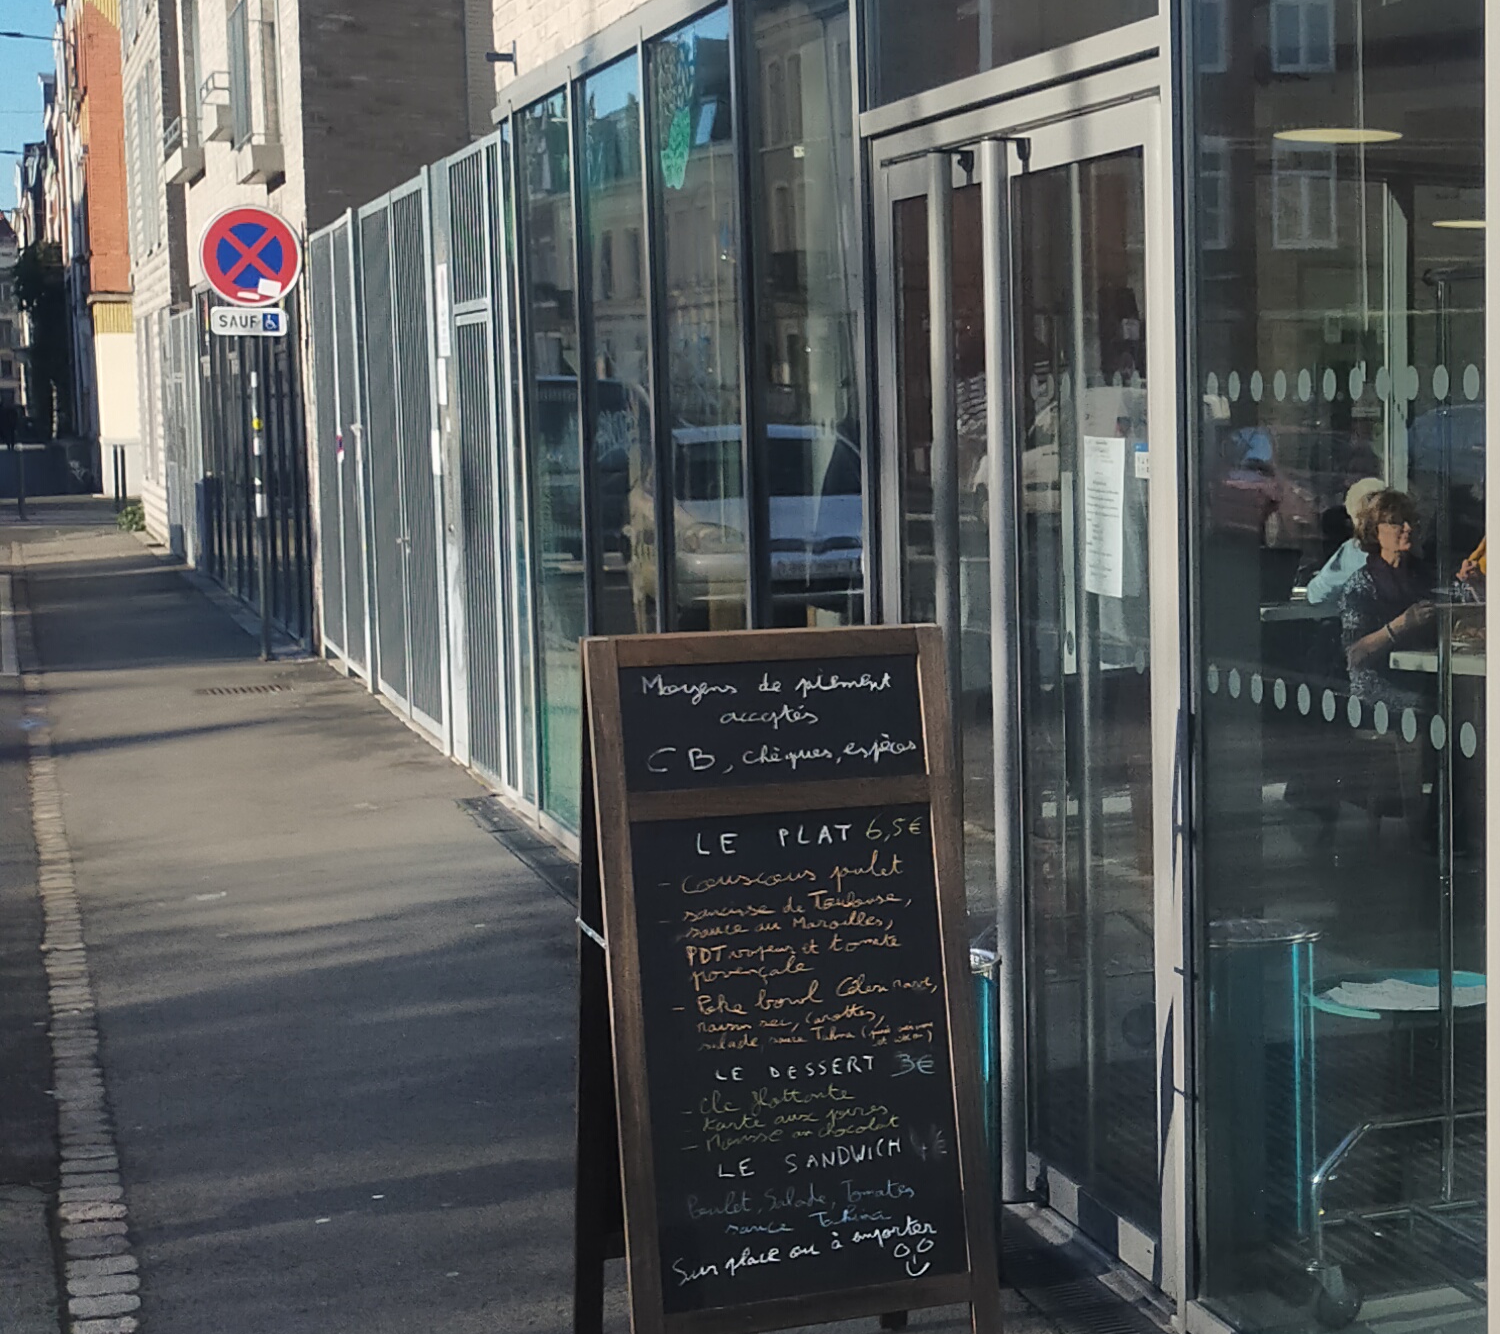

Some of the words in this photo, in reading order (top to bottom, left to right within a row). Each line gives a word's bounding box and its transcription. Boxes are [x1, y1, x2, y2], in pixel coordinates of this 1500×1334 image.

[218, 315, 259, 329] SAUF
[641, 673, 738, 705] Moyens
[758, 672, 781, 694] de
[842, 733, 918, 763] espèces
[696, 832, 739, 855] LE
[777, 824, 852, 847] PLAT
[865, 817, 922, 841] 6,5€
[782, 896, 806, 914] de
[685, 943, 729, 968] PDT
[801, 938, 820, 954] et
[714, 1066, 744, 1081] LE
[769, 1054, 875, 1078] DESSERT
[889, 1053, 936, 1078] 3€
[718, 1157, 756, 1179] LE
[784, 1138, 902, 1175] SANDWICH
[724, 1245, 783, 1277] place
[788, 1241, 821, 1259] ou
[830, 1230, 844, 1250] à
